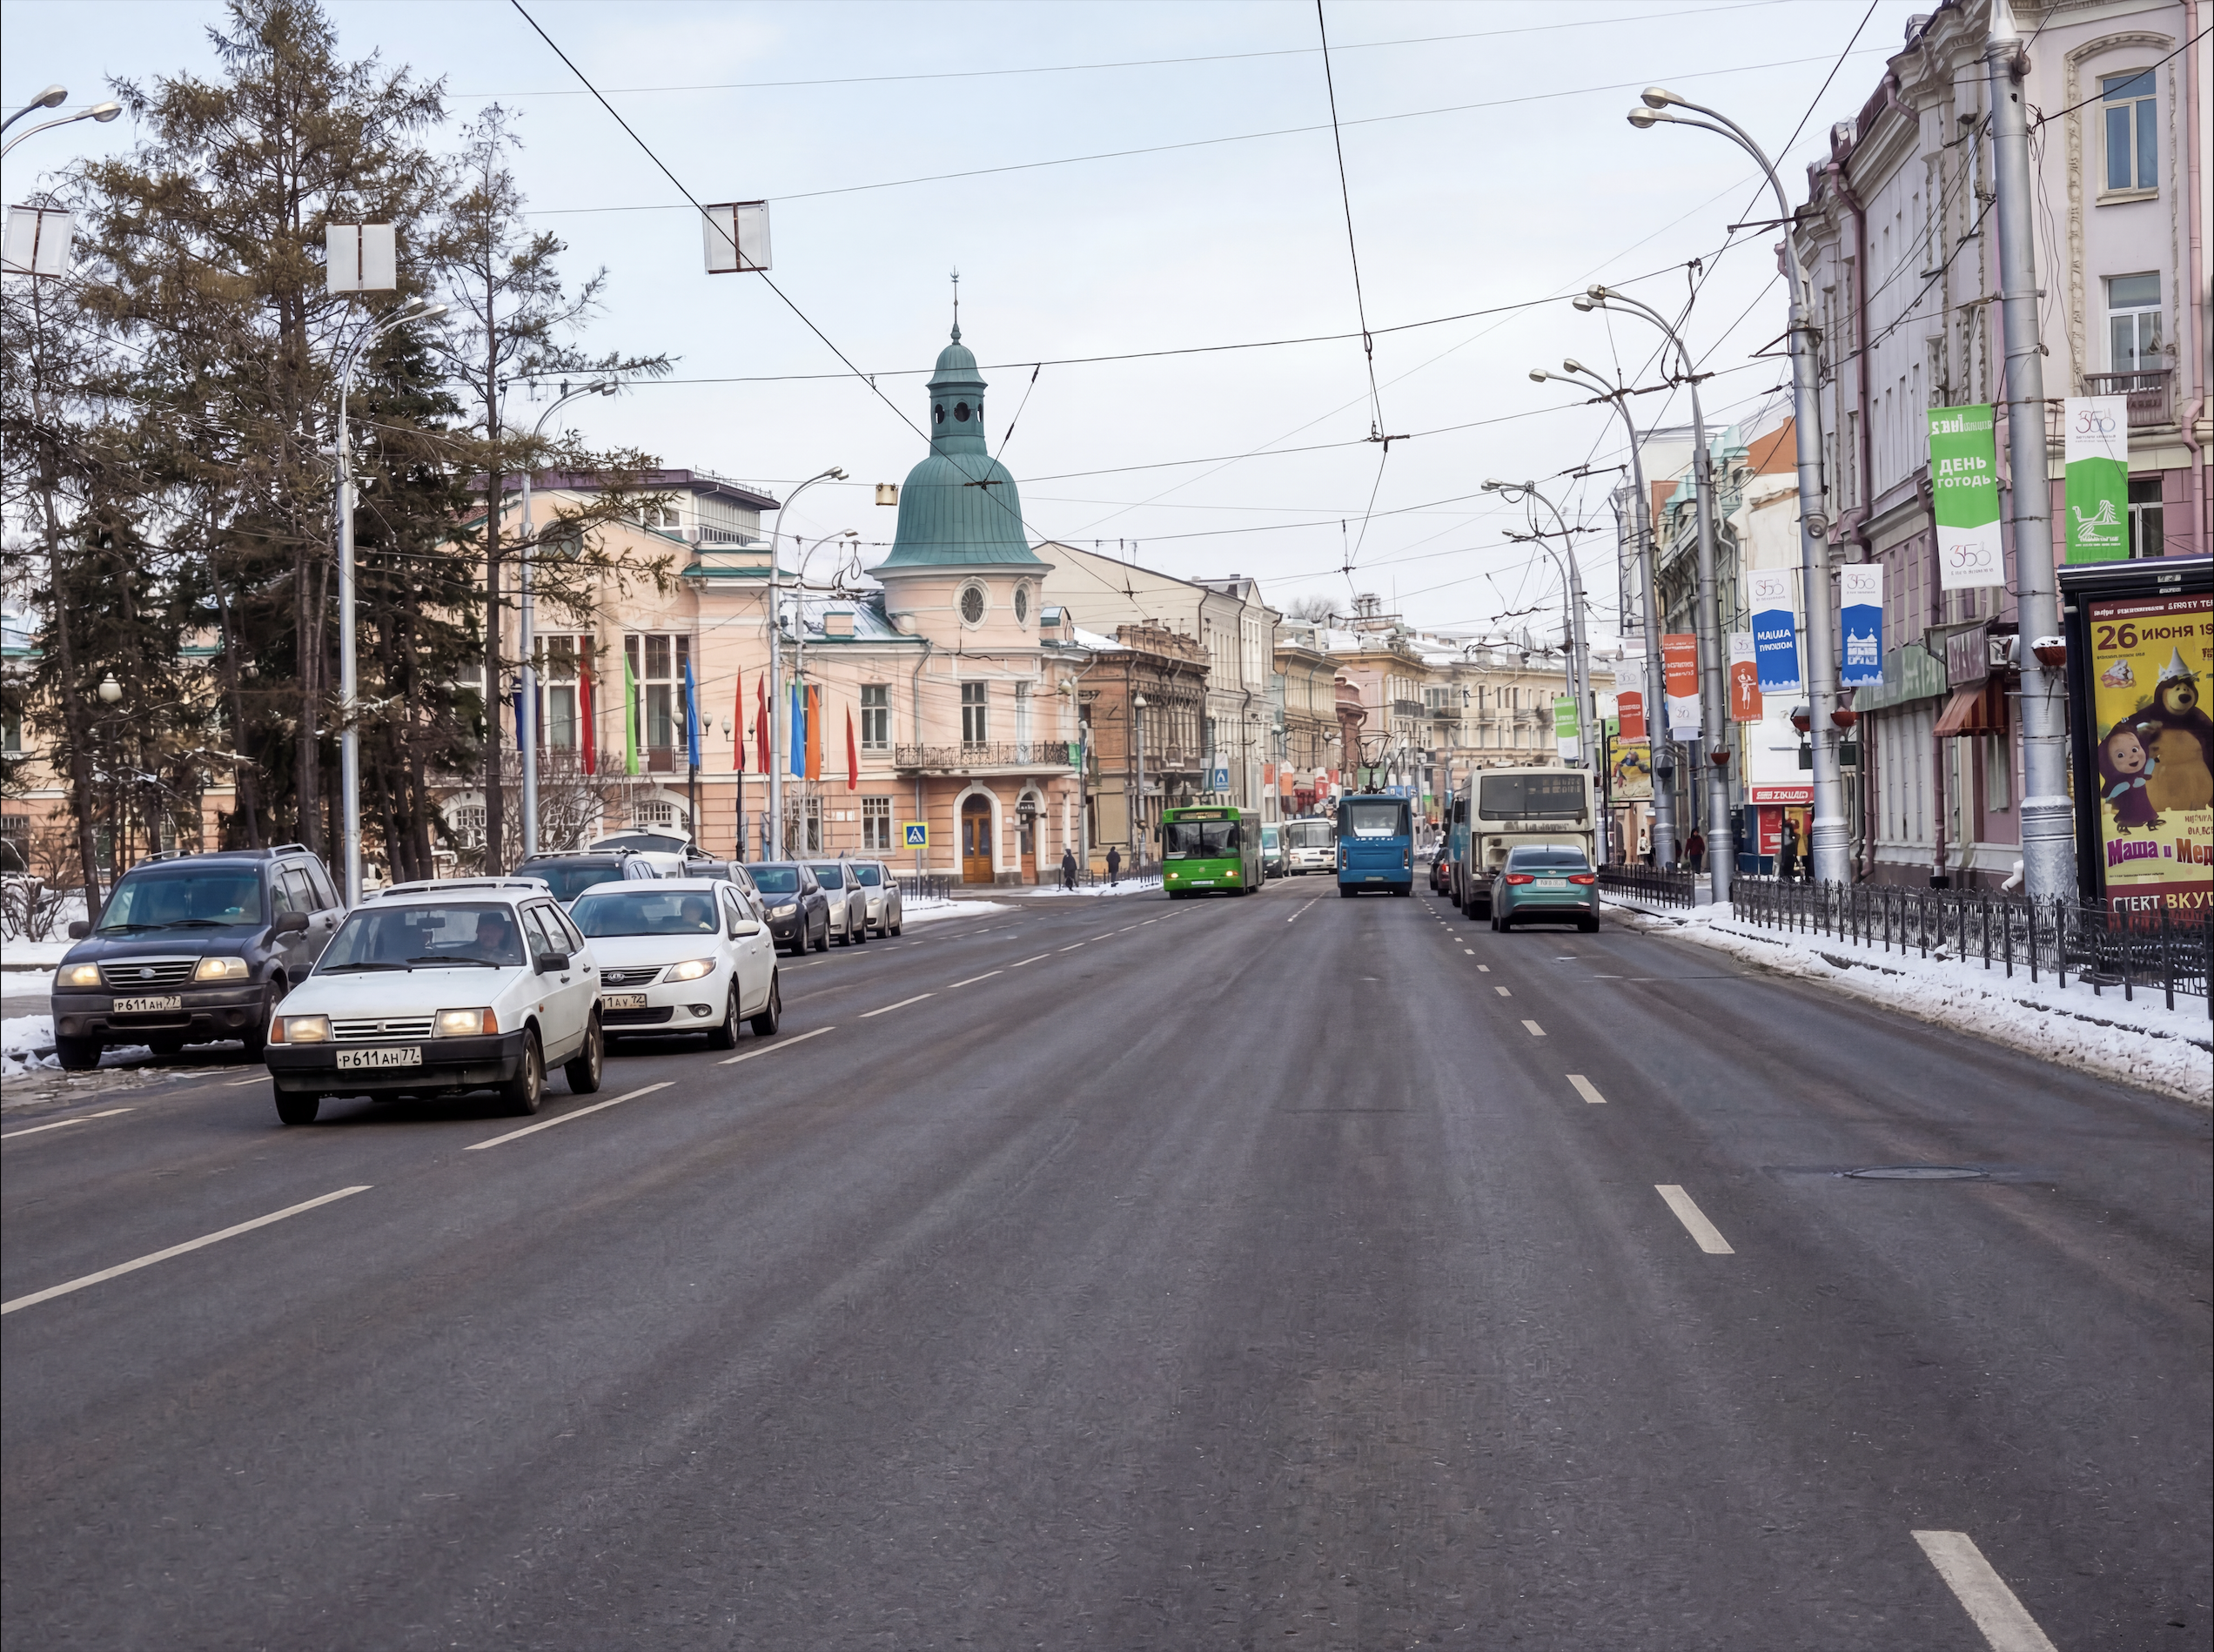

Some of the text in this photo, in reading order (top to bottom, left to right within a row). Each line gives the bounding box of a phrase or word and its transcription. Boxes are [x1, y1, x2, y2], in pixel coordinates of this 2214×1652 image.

[1939, 457, 1987, 476] ДЕНЬ
[2097, 623, 2138, 650] 26
[2142, 625, 2194, 641] ИЮНЯ
[2106, 838, 2159, 868] Маша
